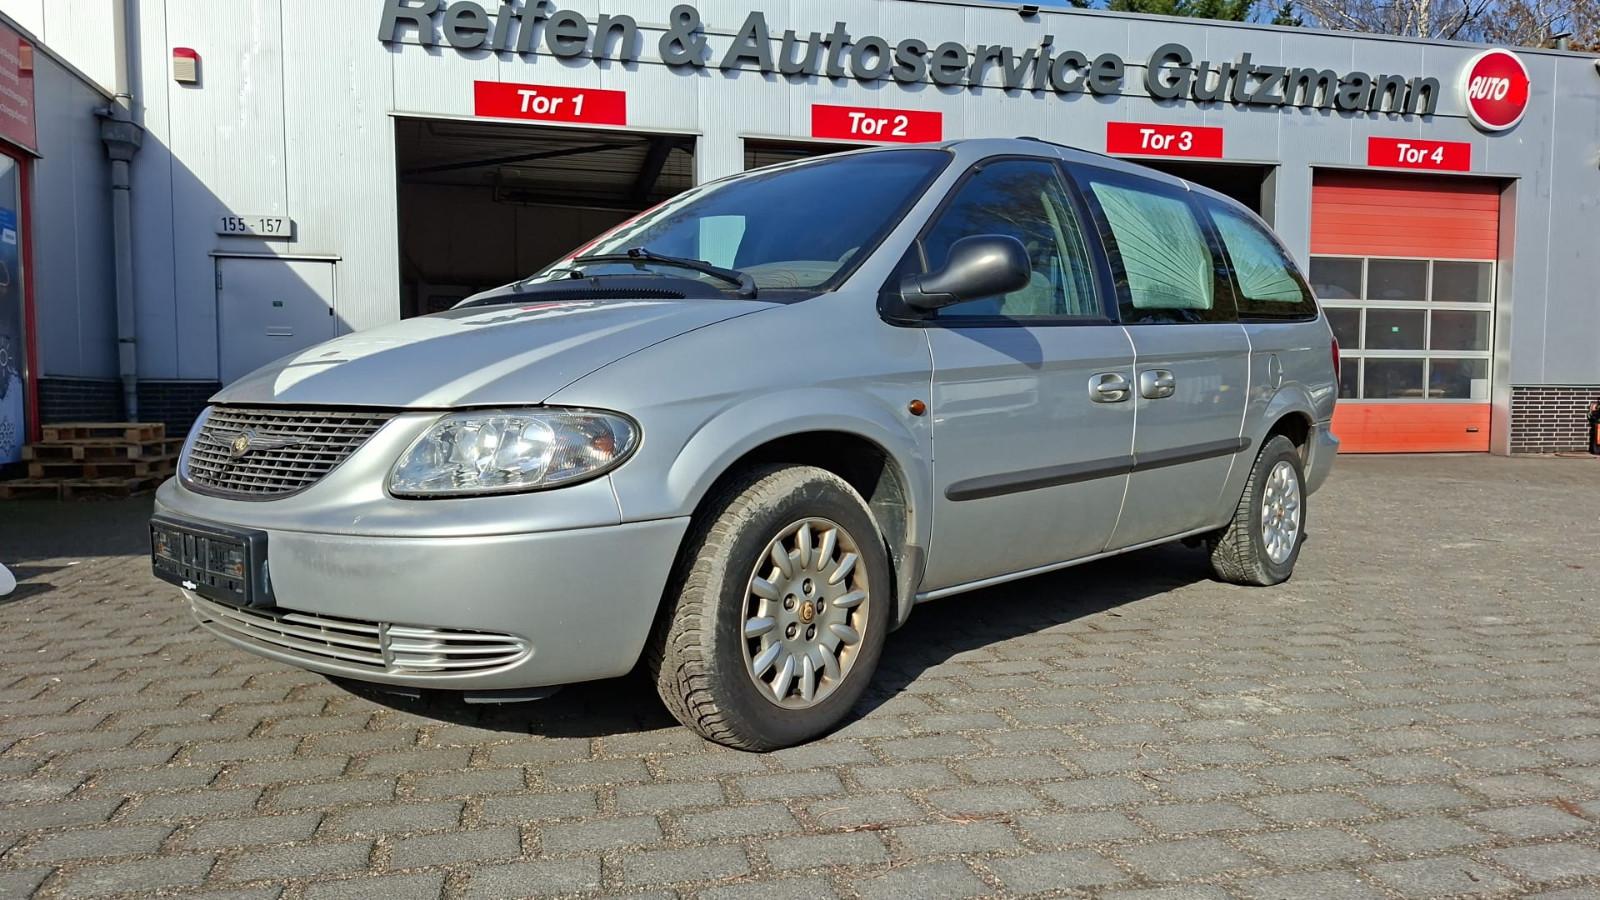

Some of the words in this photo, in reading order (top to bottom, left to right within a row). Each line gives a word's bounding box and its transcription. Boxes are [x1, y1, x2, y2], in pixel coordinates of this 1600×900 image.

[378, 0, 638, 62] Reifen
[658, 3, 708, 67] &
[720, 11, 1126, 97] Autoservice
[1146, 42, 1441, 116] Gutzmann
[1469, 75, 1510, 101] AUTO
[517, 89, 563, 115] Tor
[571, 94, 585, 116] 1
[848, 111, 887, 135] Tor
[892, 116, 908, 137] 2
[1140, 127, 1175, 150] Tor
[1179, 129, 1193, 151] 3
[1397, 143, 1426, 164] Tor
[1429, 144, 1444, 165] 4
[221, 216, 246, 232] 155
[260, 218, 282, 233] 157
